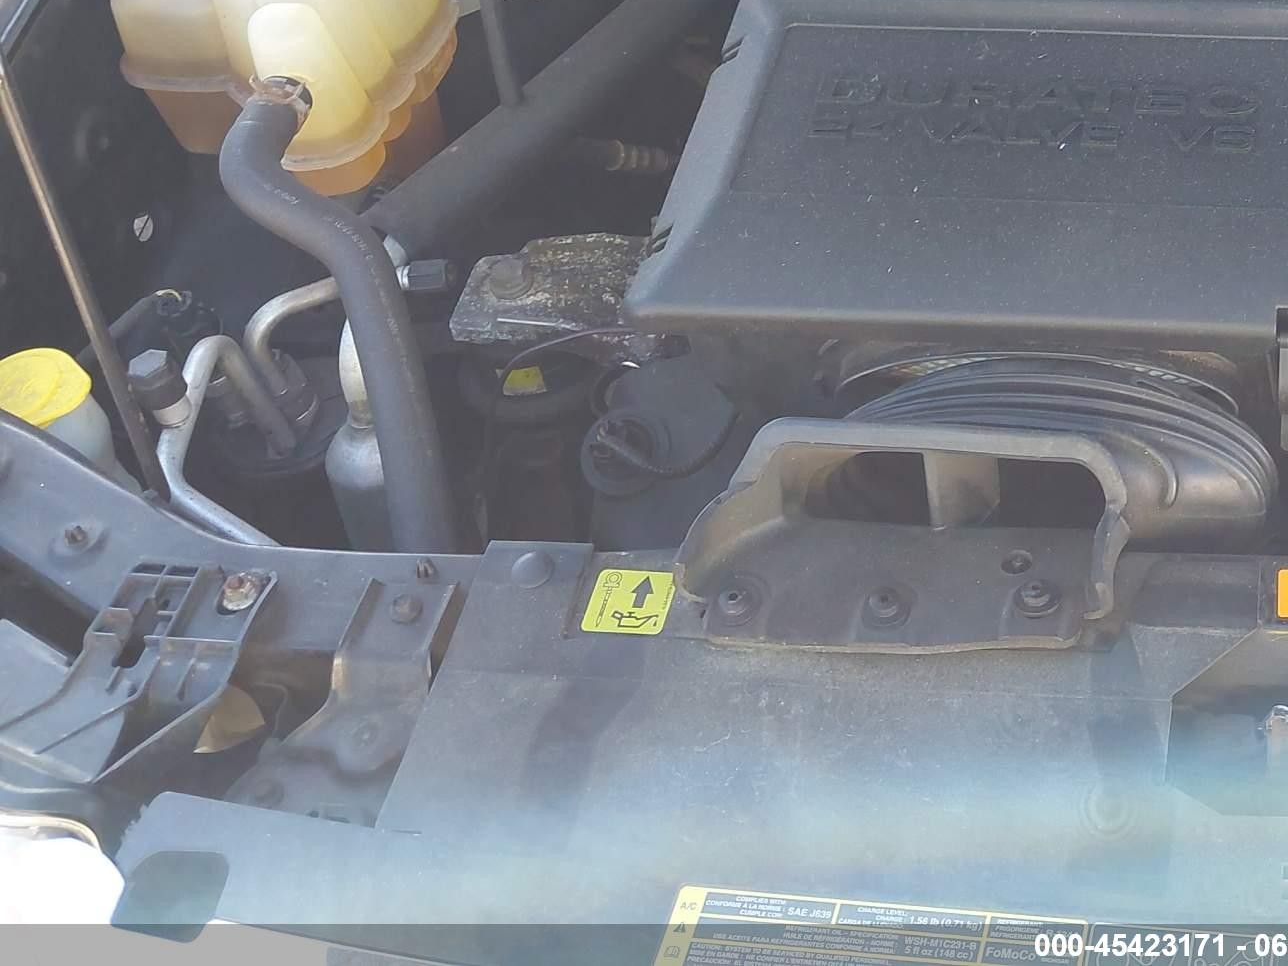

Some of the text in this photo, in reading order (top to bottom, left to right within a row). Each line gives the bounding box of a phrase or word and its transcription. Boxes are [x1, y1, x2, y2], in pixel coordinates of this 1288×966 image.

[813, 75, 1259, 117] DURATEC
[921, 118, 1121, 151] VALVE
[1169, 122, 1256, 154] V6
[680, 901, 697, 912] A/C
[787, 906, 832, 919] SAE J639
[903, 945, 911, 954] 5
[985, 946, 1036, 961] FoMoCo
